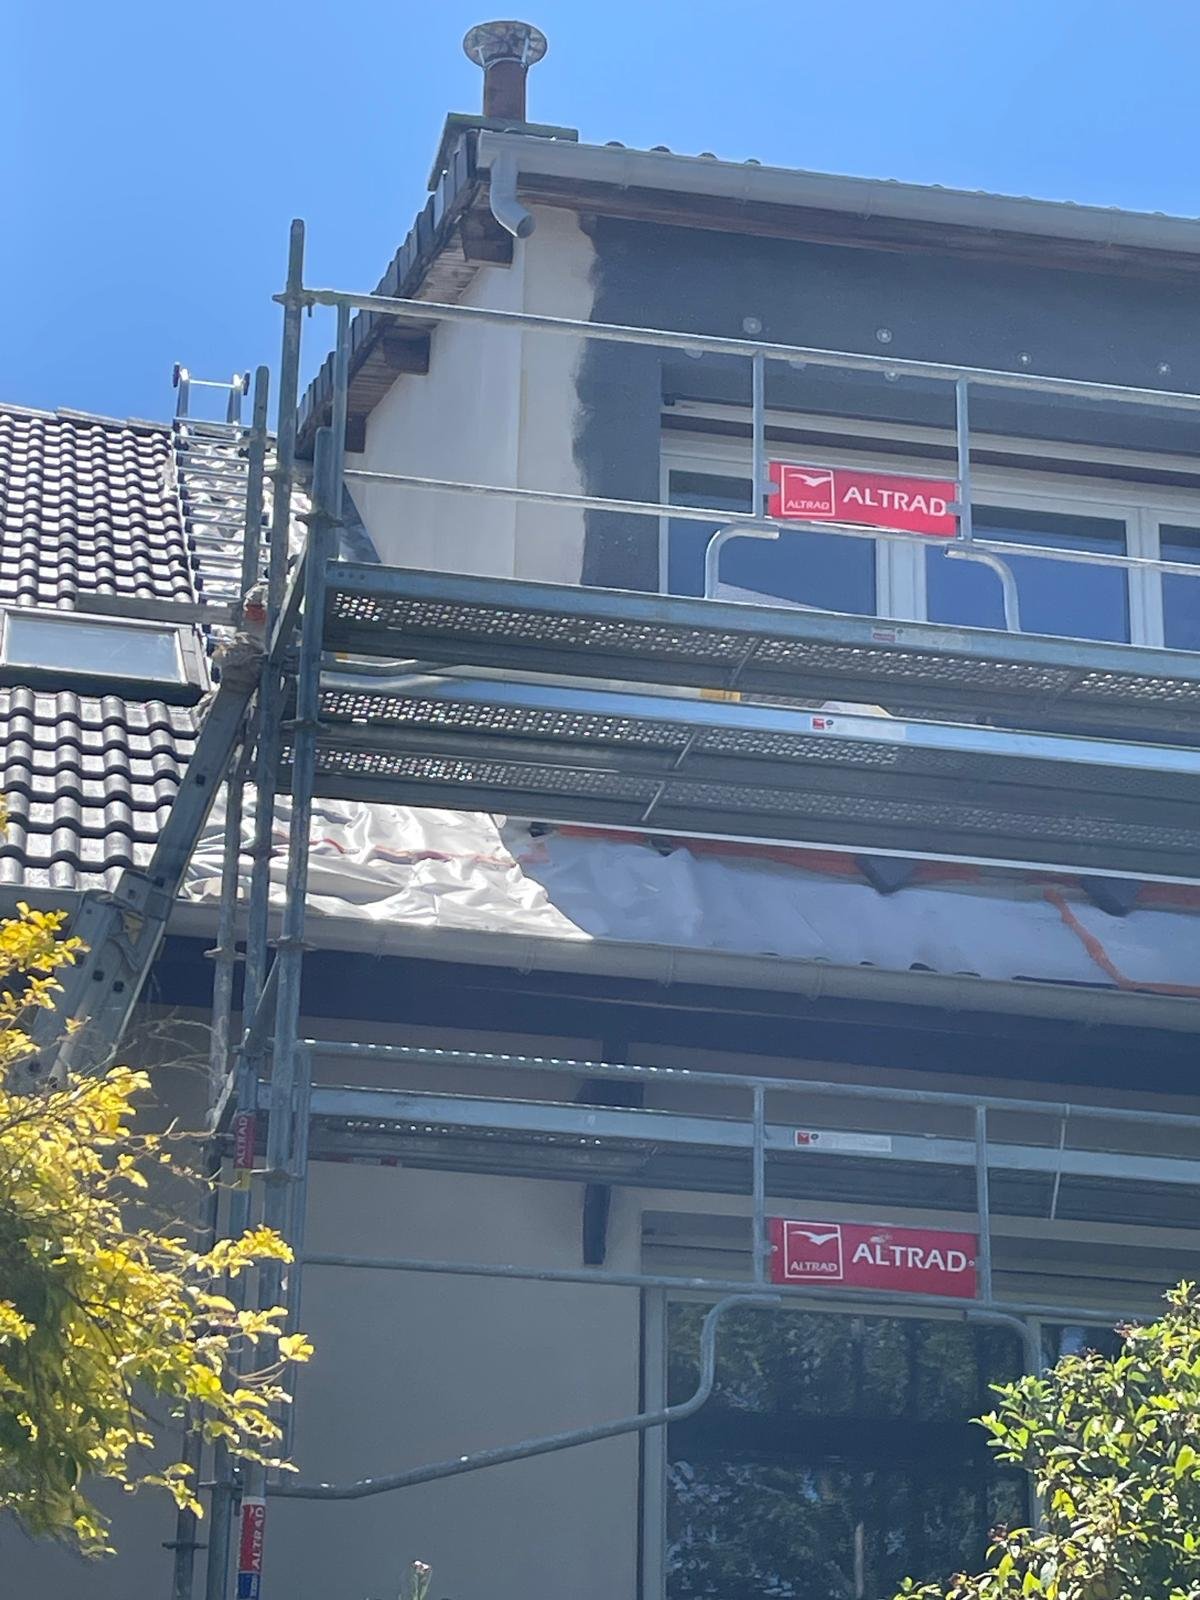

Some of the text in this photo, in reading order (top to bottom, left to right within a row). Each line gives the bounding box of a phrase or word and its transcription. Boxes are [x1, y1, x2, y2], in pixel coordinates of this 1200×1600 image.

[786, 500, 830, 511] ALTRAD
[843, 486, 947, 517] ALTRAD
[237, 1116, 248, 1166] ALTRAD
[790, 1261, 838, 1272] ALTRAD
[853, 1243, 967, 1272] ALTRAD
[252, 1506, 264, 1570] ALTRAD
